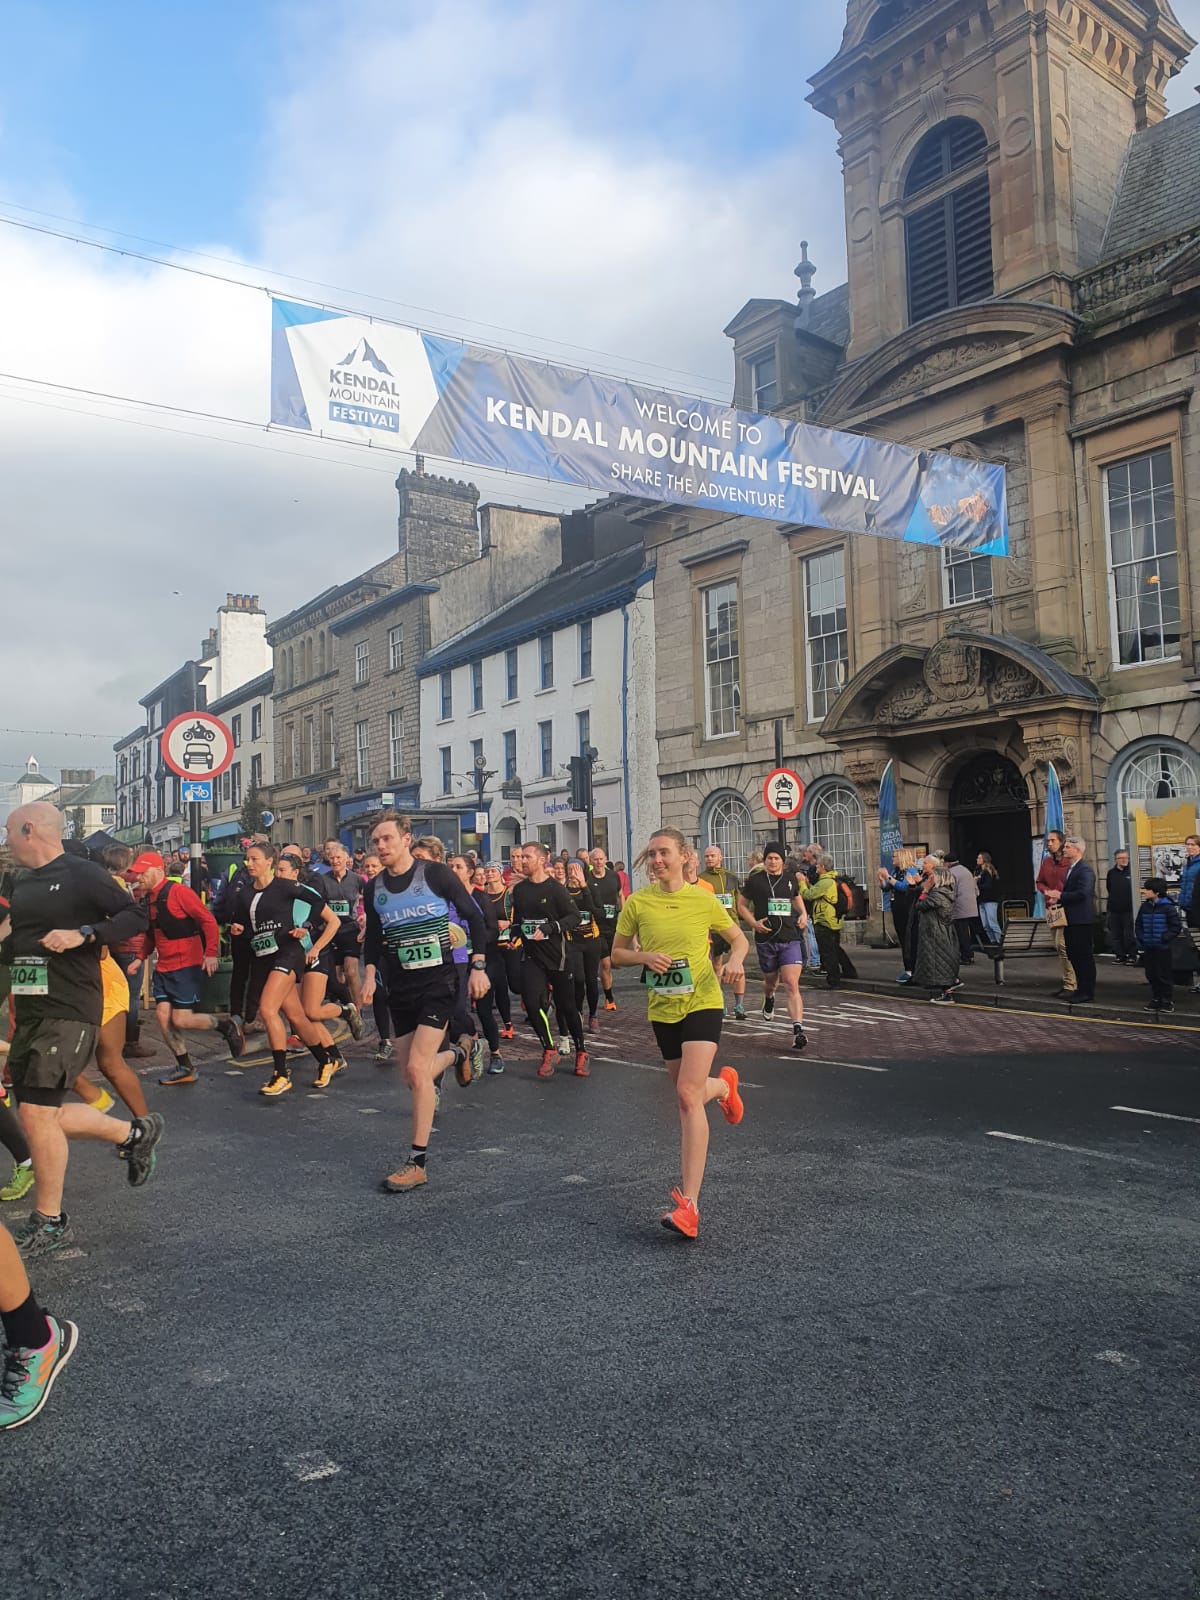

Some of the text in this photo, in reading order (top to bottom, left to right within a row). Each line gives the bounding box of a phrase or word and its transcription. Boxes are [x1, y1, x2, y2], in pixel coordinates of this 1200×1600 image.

[329, 368, 400, 397] KENDAL
[329, 387, 400, 411] MOUNTAIN
[332, 406, 396, 429] FESTIVAL
[634, 397, 762, 445] WELCOME TO
[486, 396, 880, 502] KENDAL MOUNTAIN FESTIVAL
[611, 462, 786, 510] SHARE THE ADVENTURE
[406, 946, 432, 962] 215
[652, 971, 684, 987] 270
